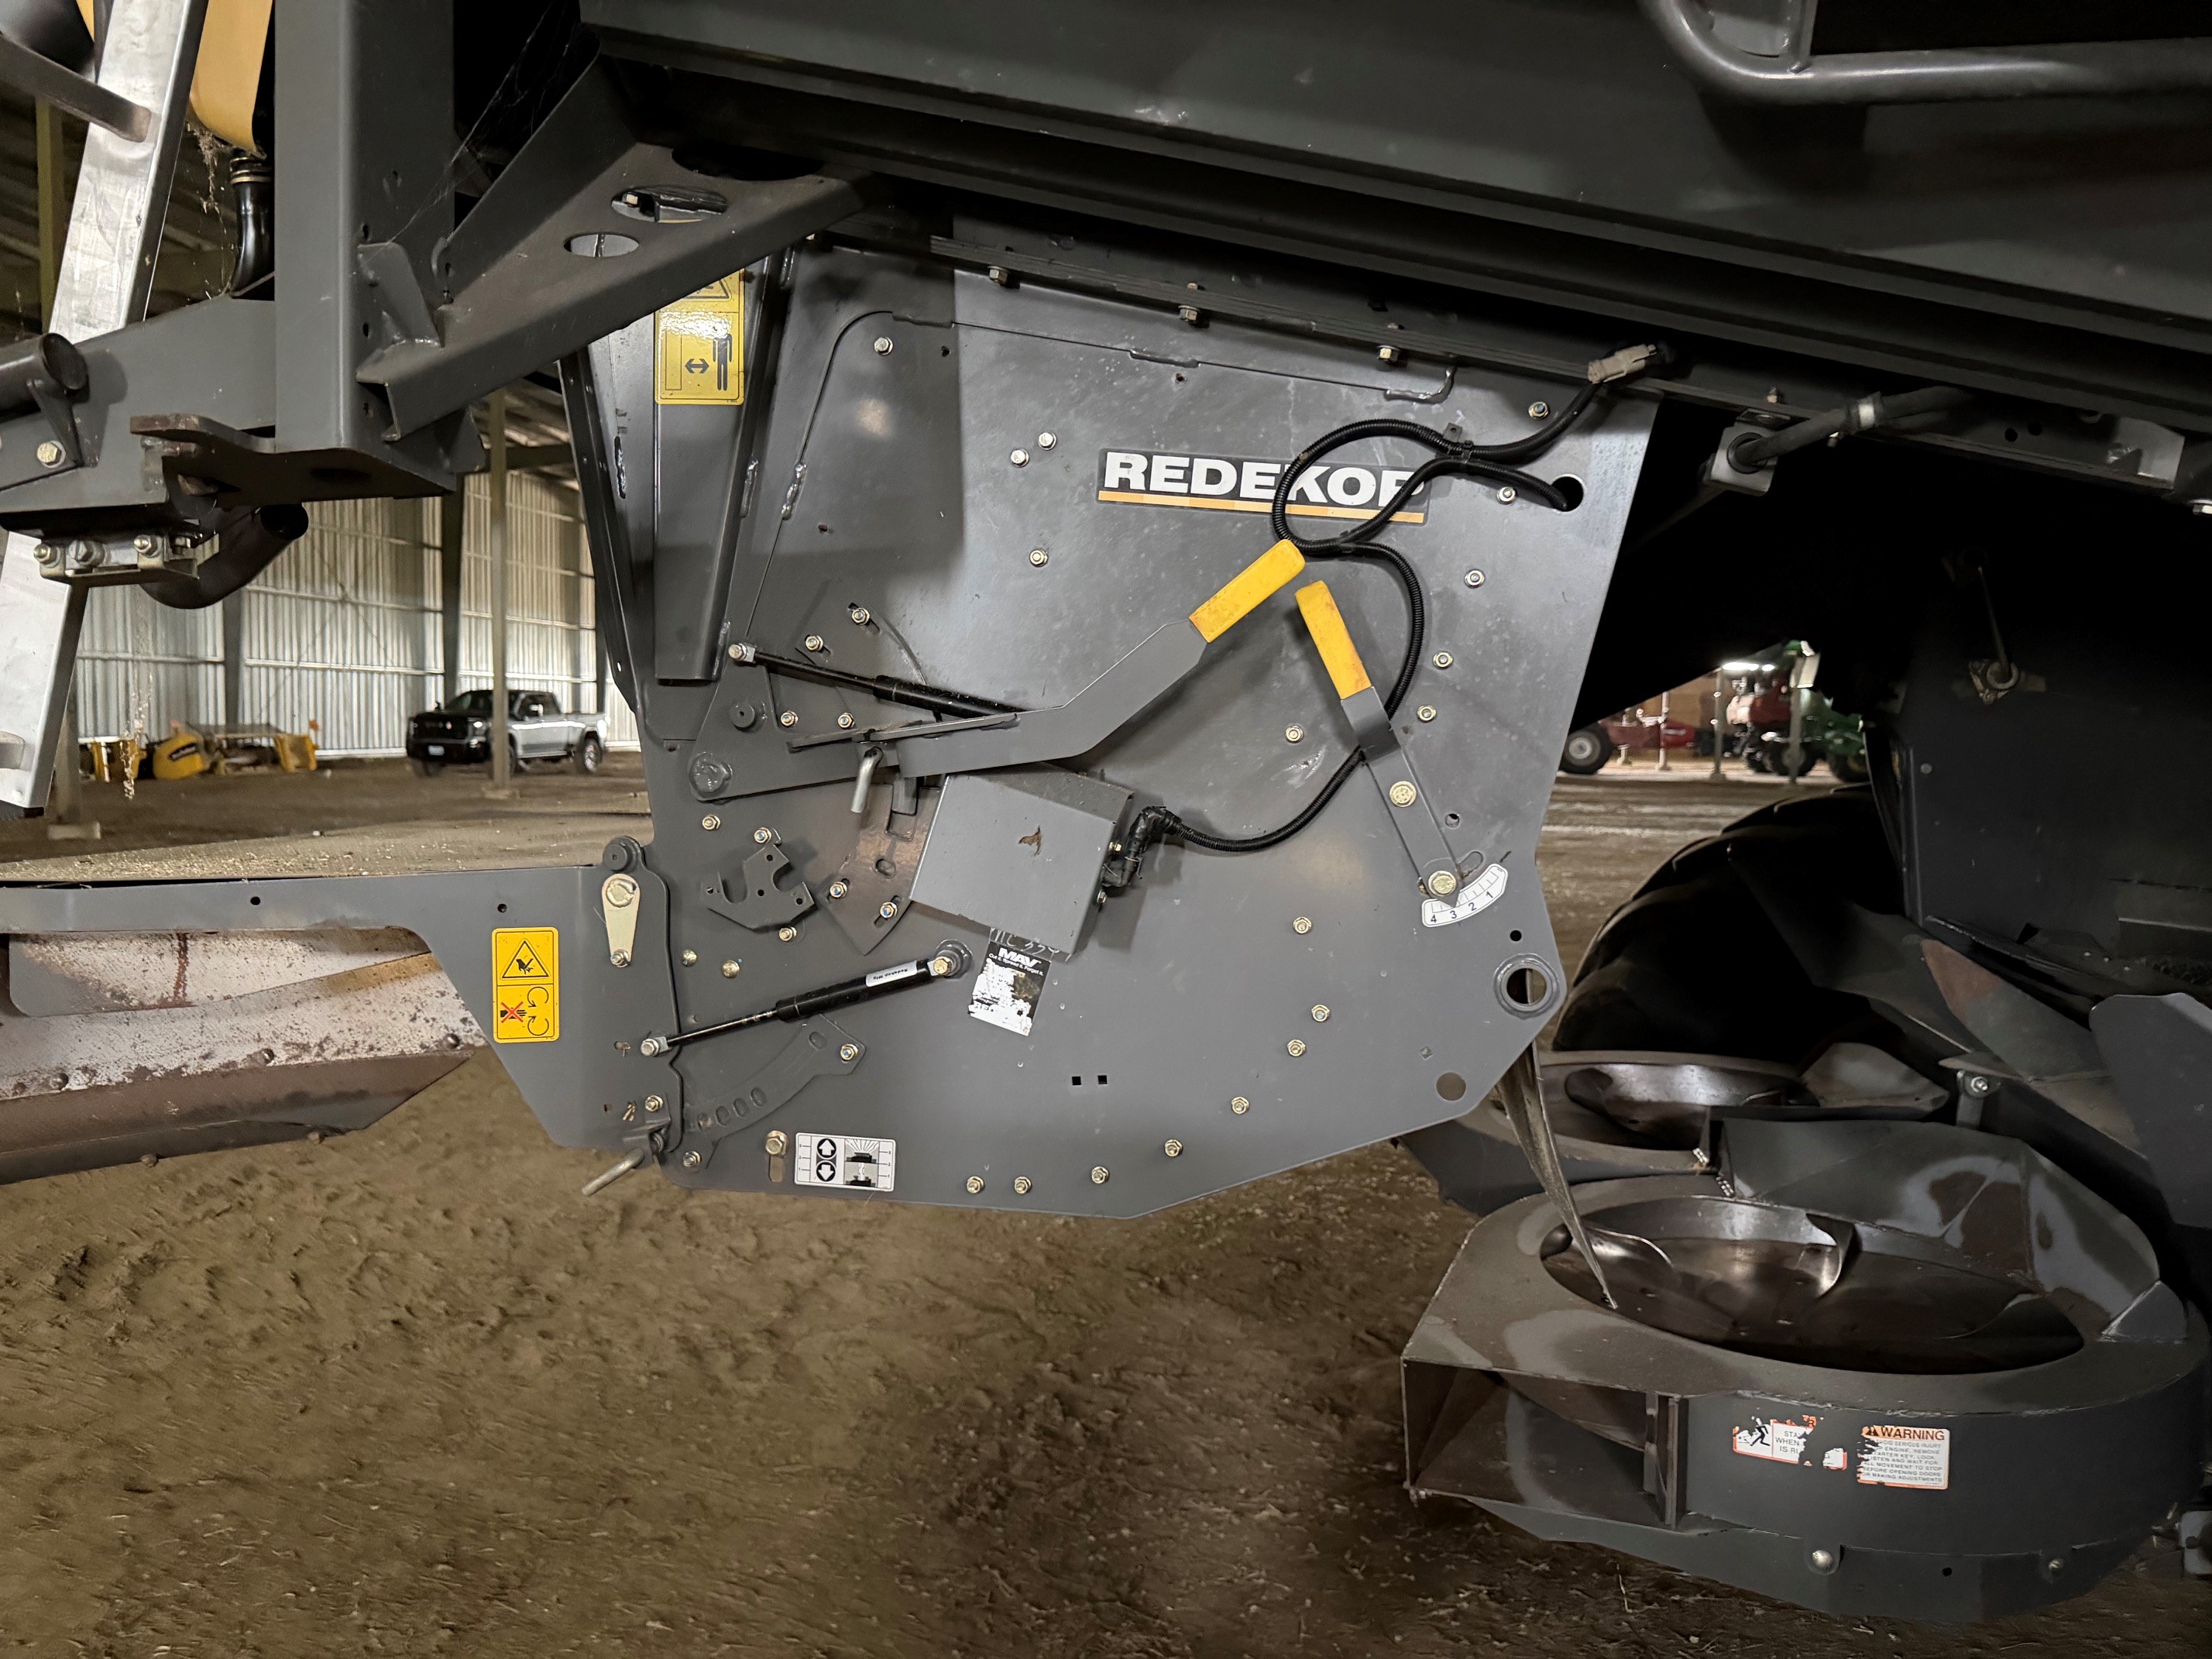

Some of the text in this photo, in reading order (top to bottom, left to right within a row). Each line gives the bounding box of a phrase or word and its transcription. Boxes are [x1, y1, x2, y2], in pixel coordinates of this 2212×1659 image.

[1431, 914, 1437, 922] 4
[1450, 910, 1457, 919] 3
[1468, 902, 1477, 911] 2
[998, 947, 1039, 967] MAV
[1774, 1437, 1799, 1446] WHEN
[1881, 1427, 1945, 1441] WARNING
